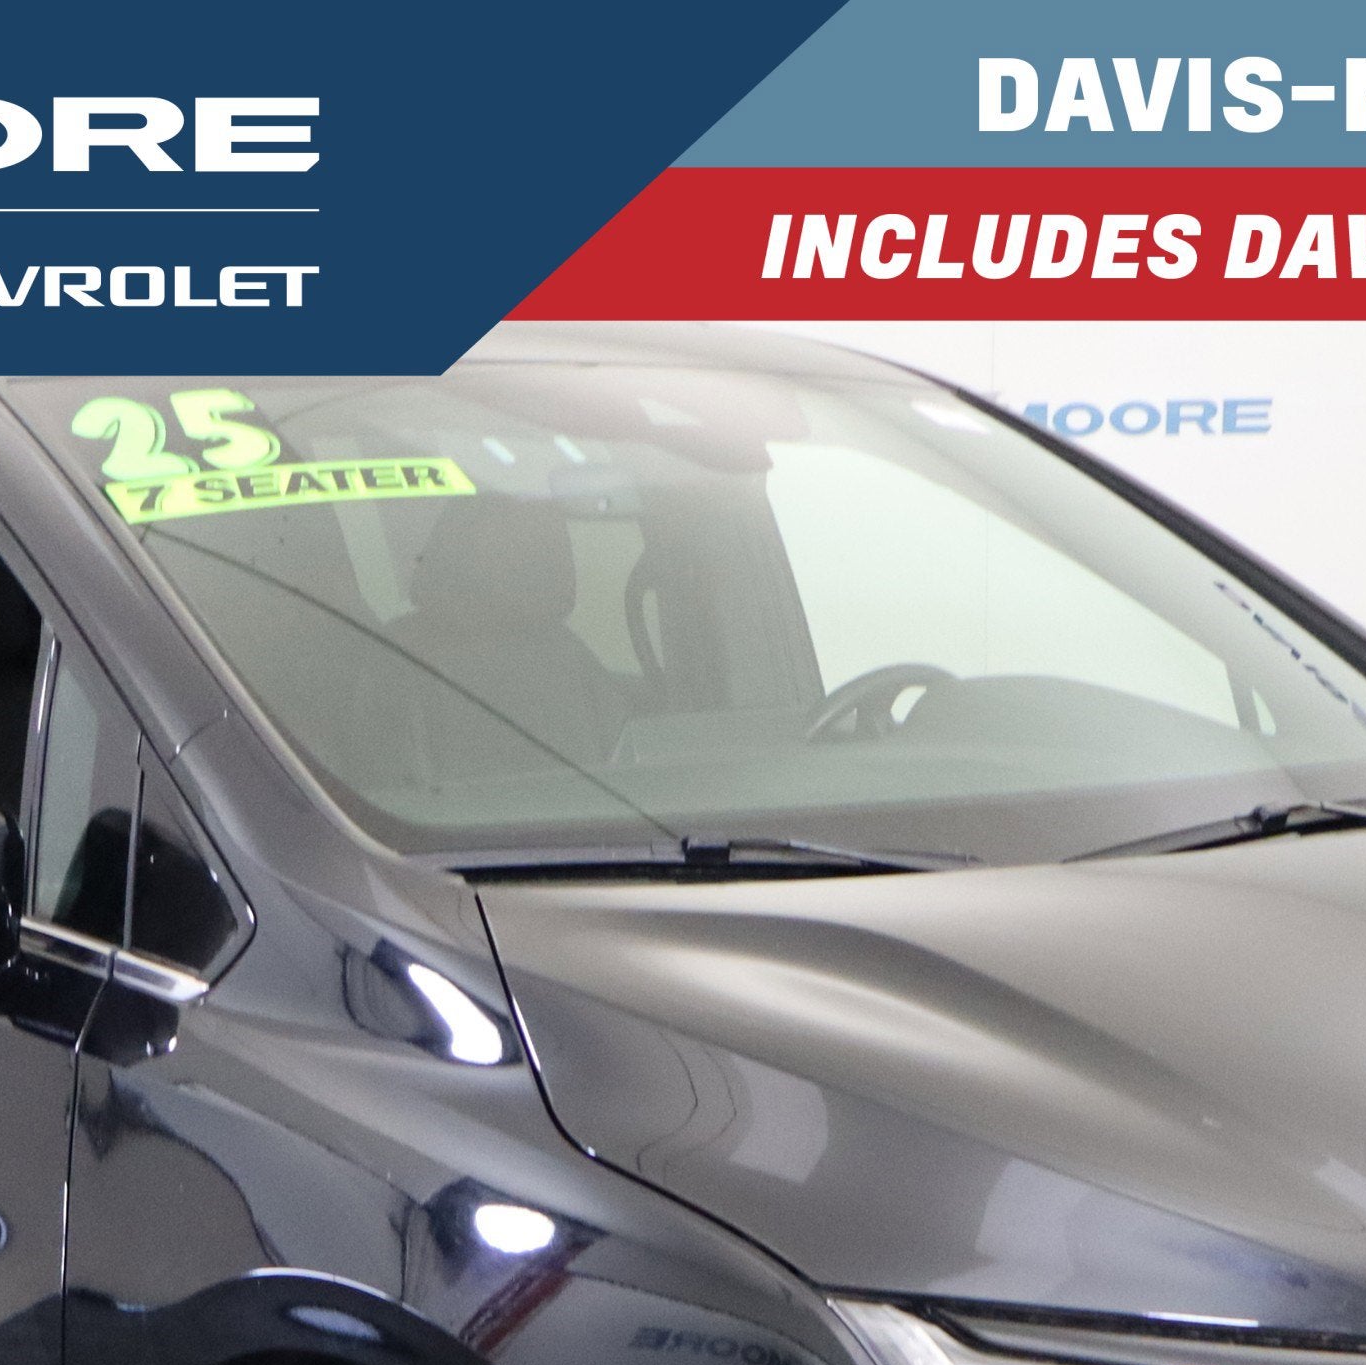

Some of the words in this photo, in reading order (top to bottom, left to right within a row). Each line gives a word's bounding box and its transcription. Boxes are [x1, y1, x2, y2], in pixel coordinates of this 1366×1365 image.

[71, 388, 281, 482] 25
[125, 483, 167, 513] 7
[192, 465, 447, 505] SEATER
